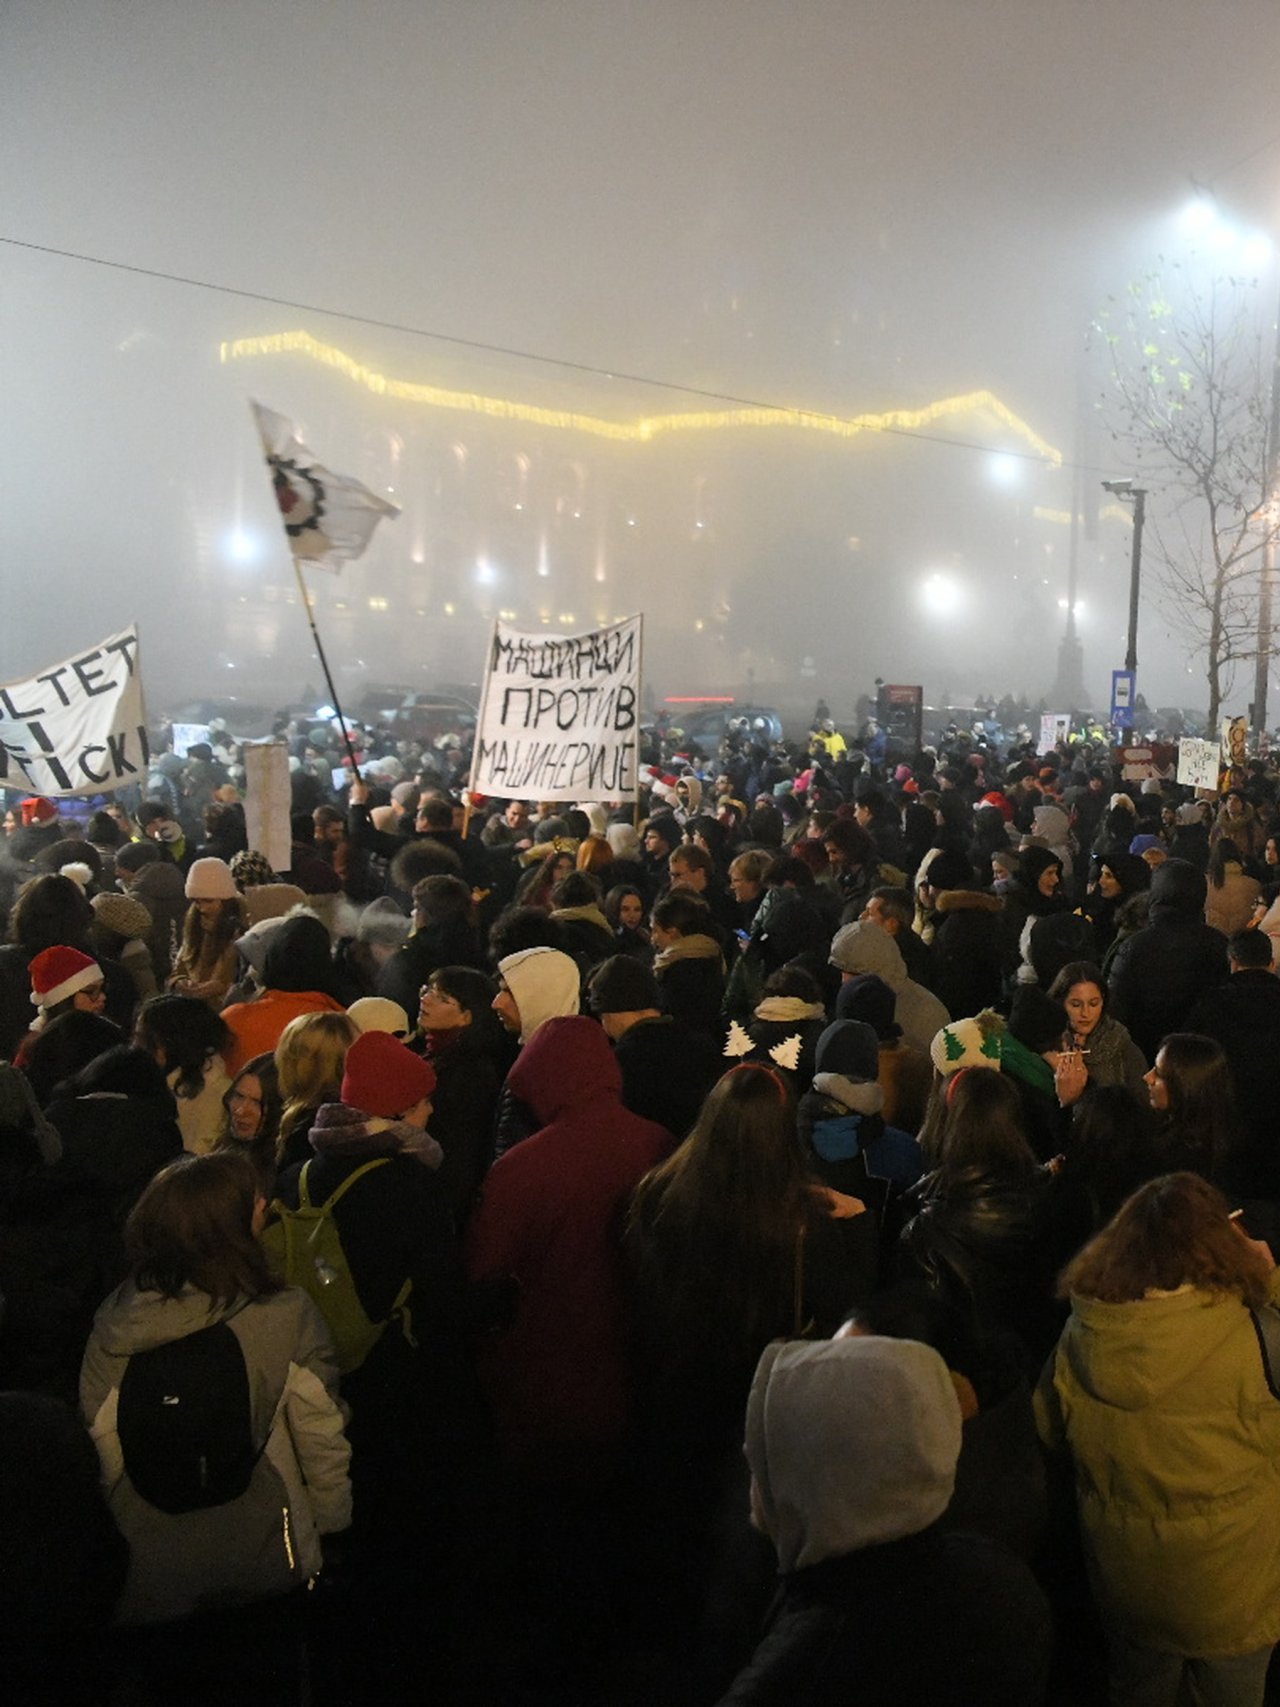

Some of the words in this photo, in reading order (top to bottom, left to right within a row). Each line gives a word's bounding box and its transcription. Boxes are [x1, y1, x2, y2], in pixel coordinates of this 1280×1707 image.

[0, 635, 137, 720] LTET
[492, 631, 635, 680] МАШИНЦИ
[501, 685, 636, 731] ПРОТИВ
[475, 739, 635, 792] МАШИНЕРИЈЕ
